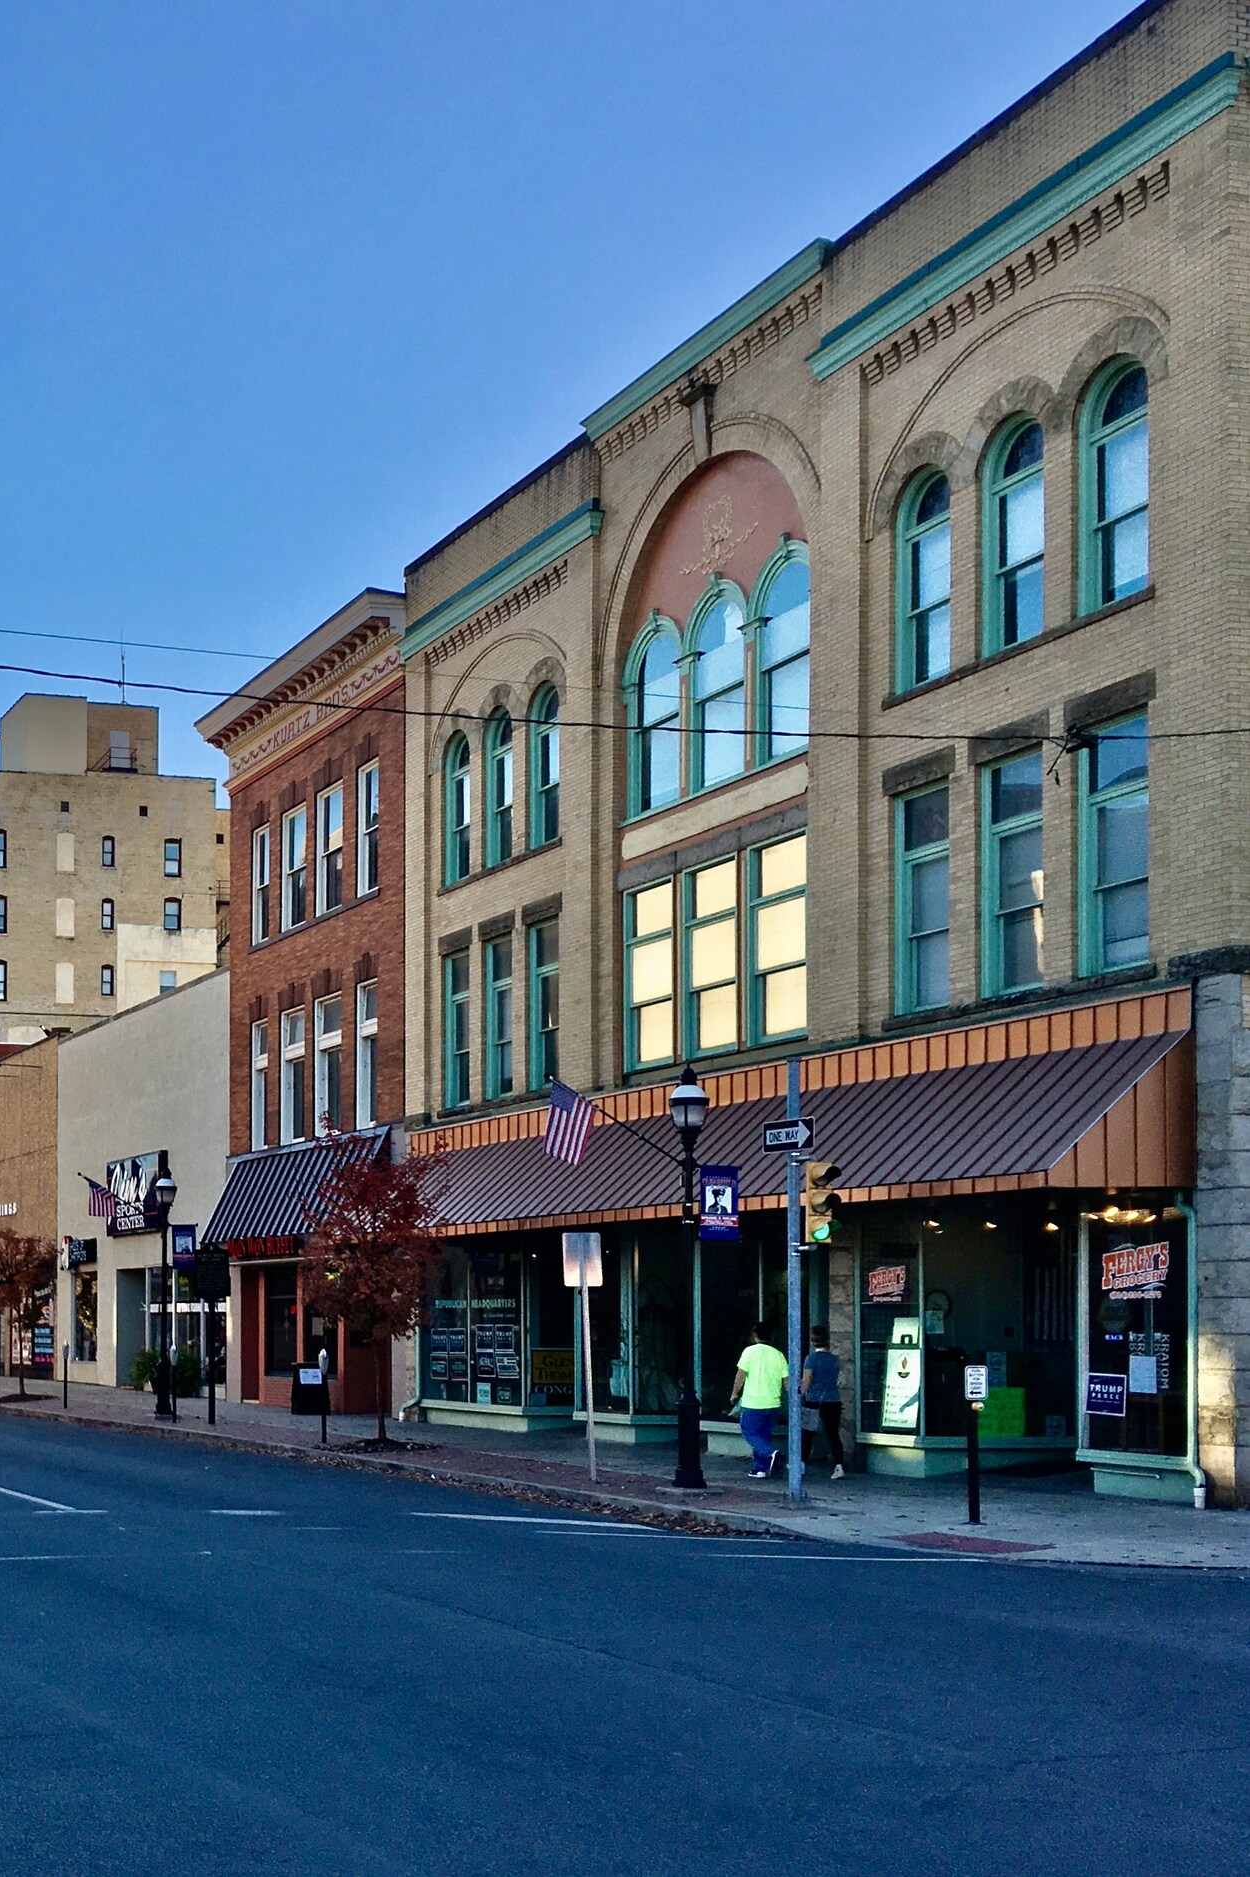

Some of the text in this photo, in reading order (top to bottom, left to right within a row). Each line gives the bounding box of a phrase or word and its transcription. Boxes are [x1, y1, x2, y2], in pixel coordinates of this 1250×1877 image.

[273, 710, 311, 749] KURTZ
[768, 1129, 799, 1143] ONE WAY
[116, 1202, 144, 1217] SPORTS
[116, 1215, 145, 1231] CENTER
[266, 1234, 295, 1254] BUFFET
[1102, 1241, 1170, 1290] FERGY'S
[1112, 1268, 1168, 1289] GROCERY
[435, 1299, 516, 1309] REPUBLICAN HEADQUARTERS
[1090, 1384, 1123, 1393] TRUMP
[1092, 1392, 1120, 1400] PENCE
